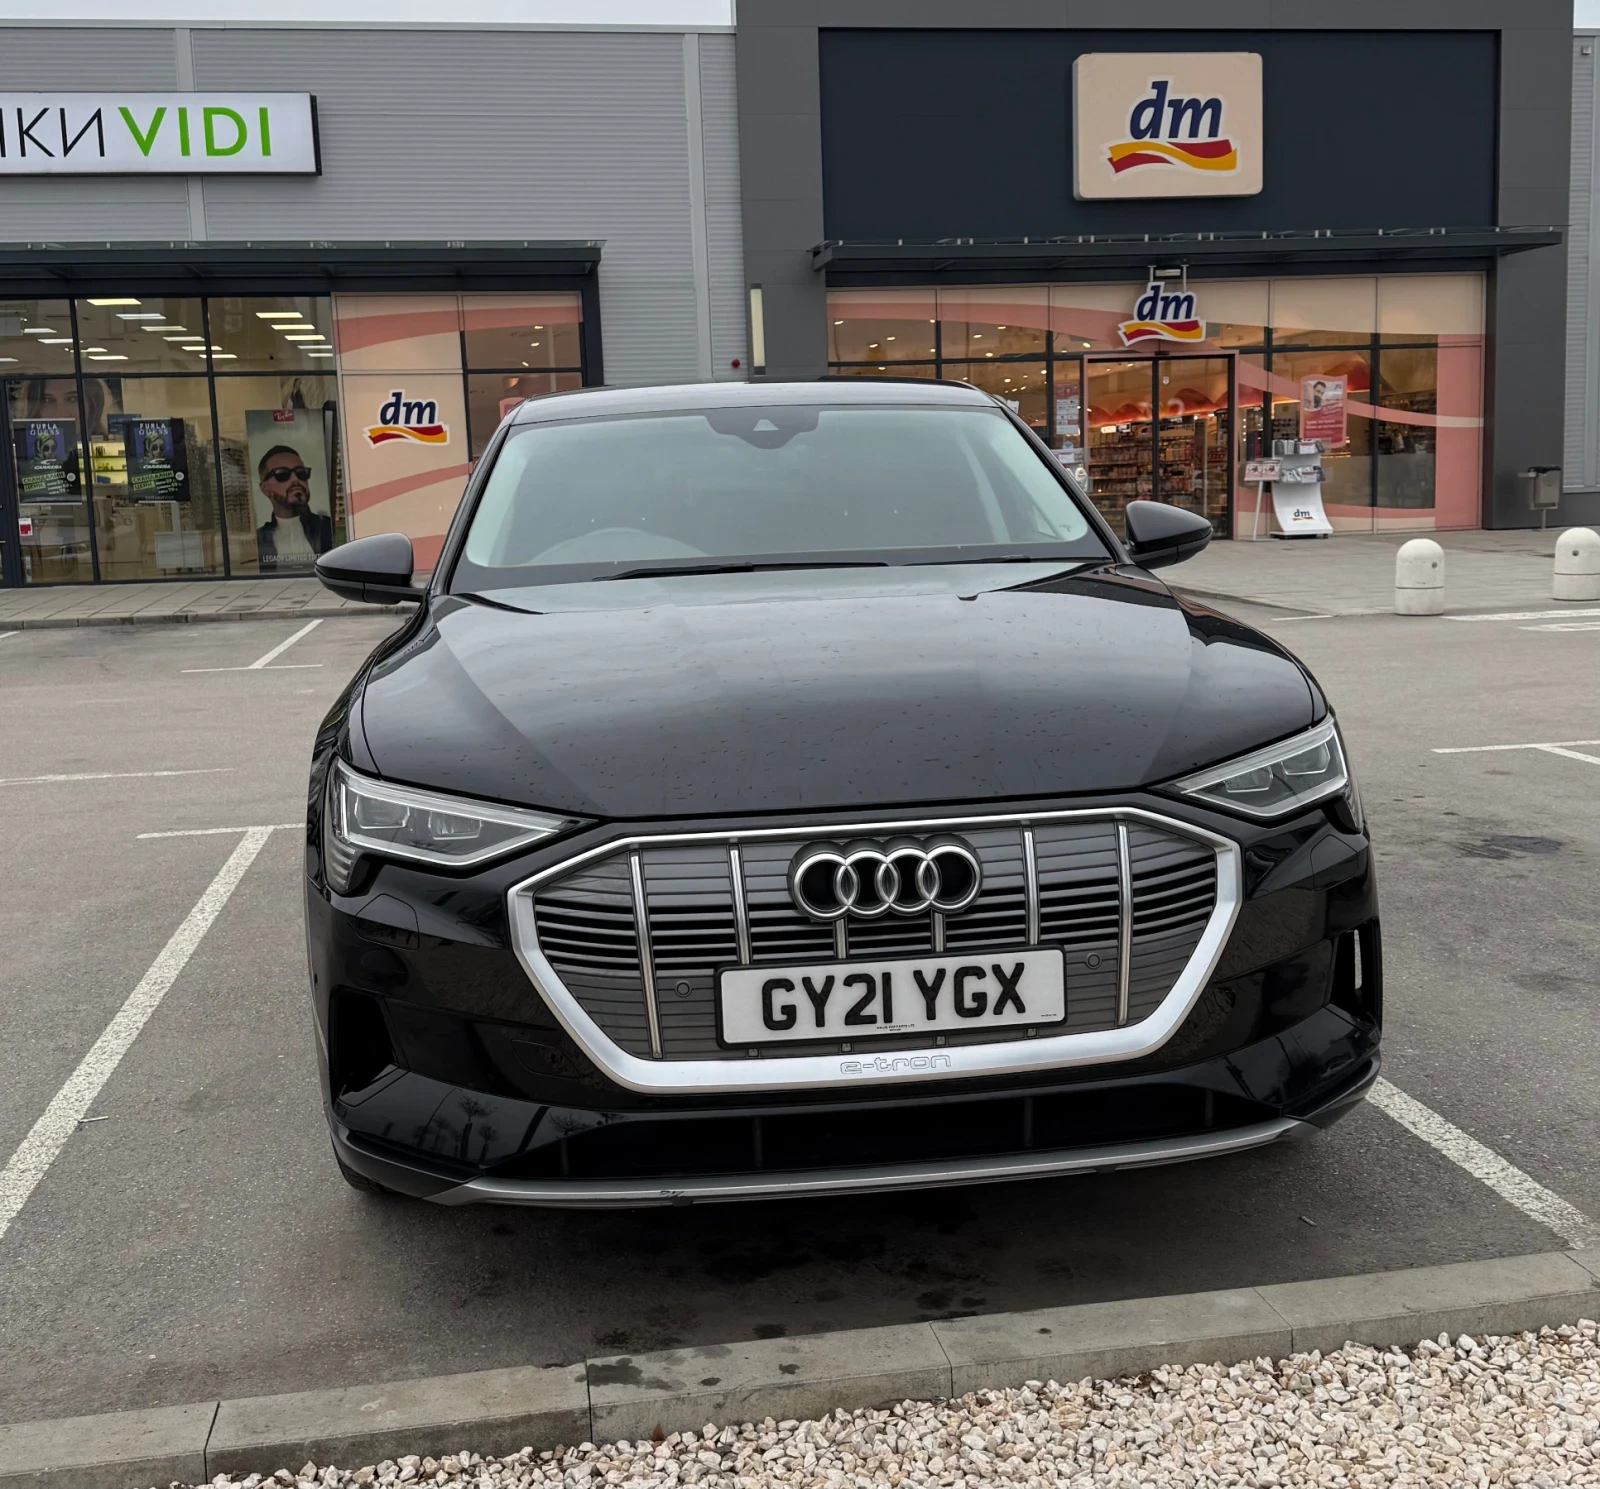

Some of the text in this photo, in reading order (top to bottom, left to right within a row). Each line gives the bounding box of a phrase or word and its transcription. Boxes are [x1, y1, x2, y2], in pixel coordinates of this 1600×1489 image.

[1130, 81, 1222, 140] dm
[117, 106, 271, 157] VIDI
[1137, 285, 1194, 321] dm
[380, 391, 436, 426] dm
[1293, 508, 1311, 518] dm
[761, 961, 1026, 1032] GY21 YGX
[840, 1055, 952, 1075] e-tron
